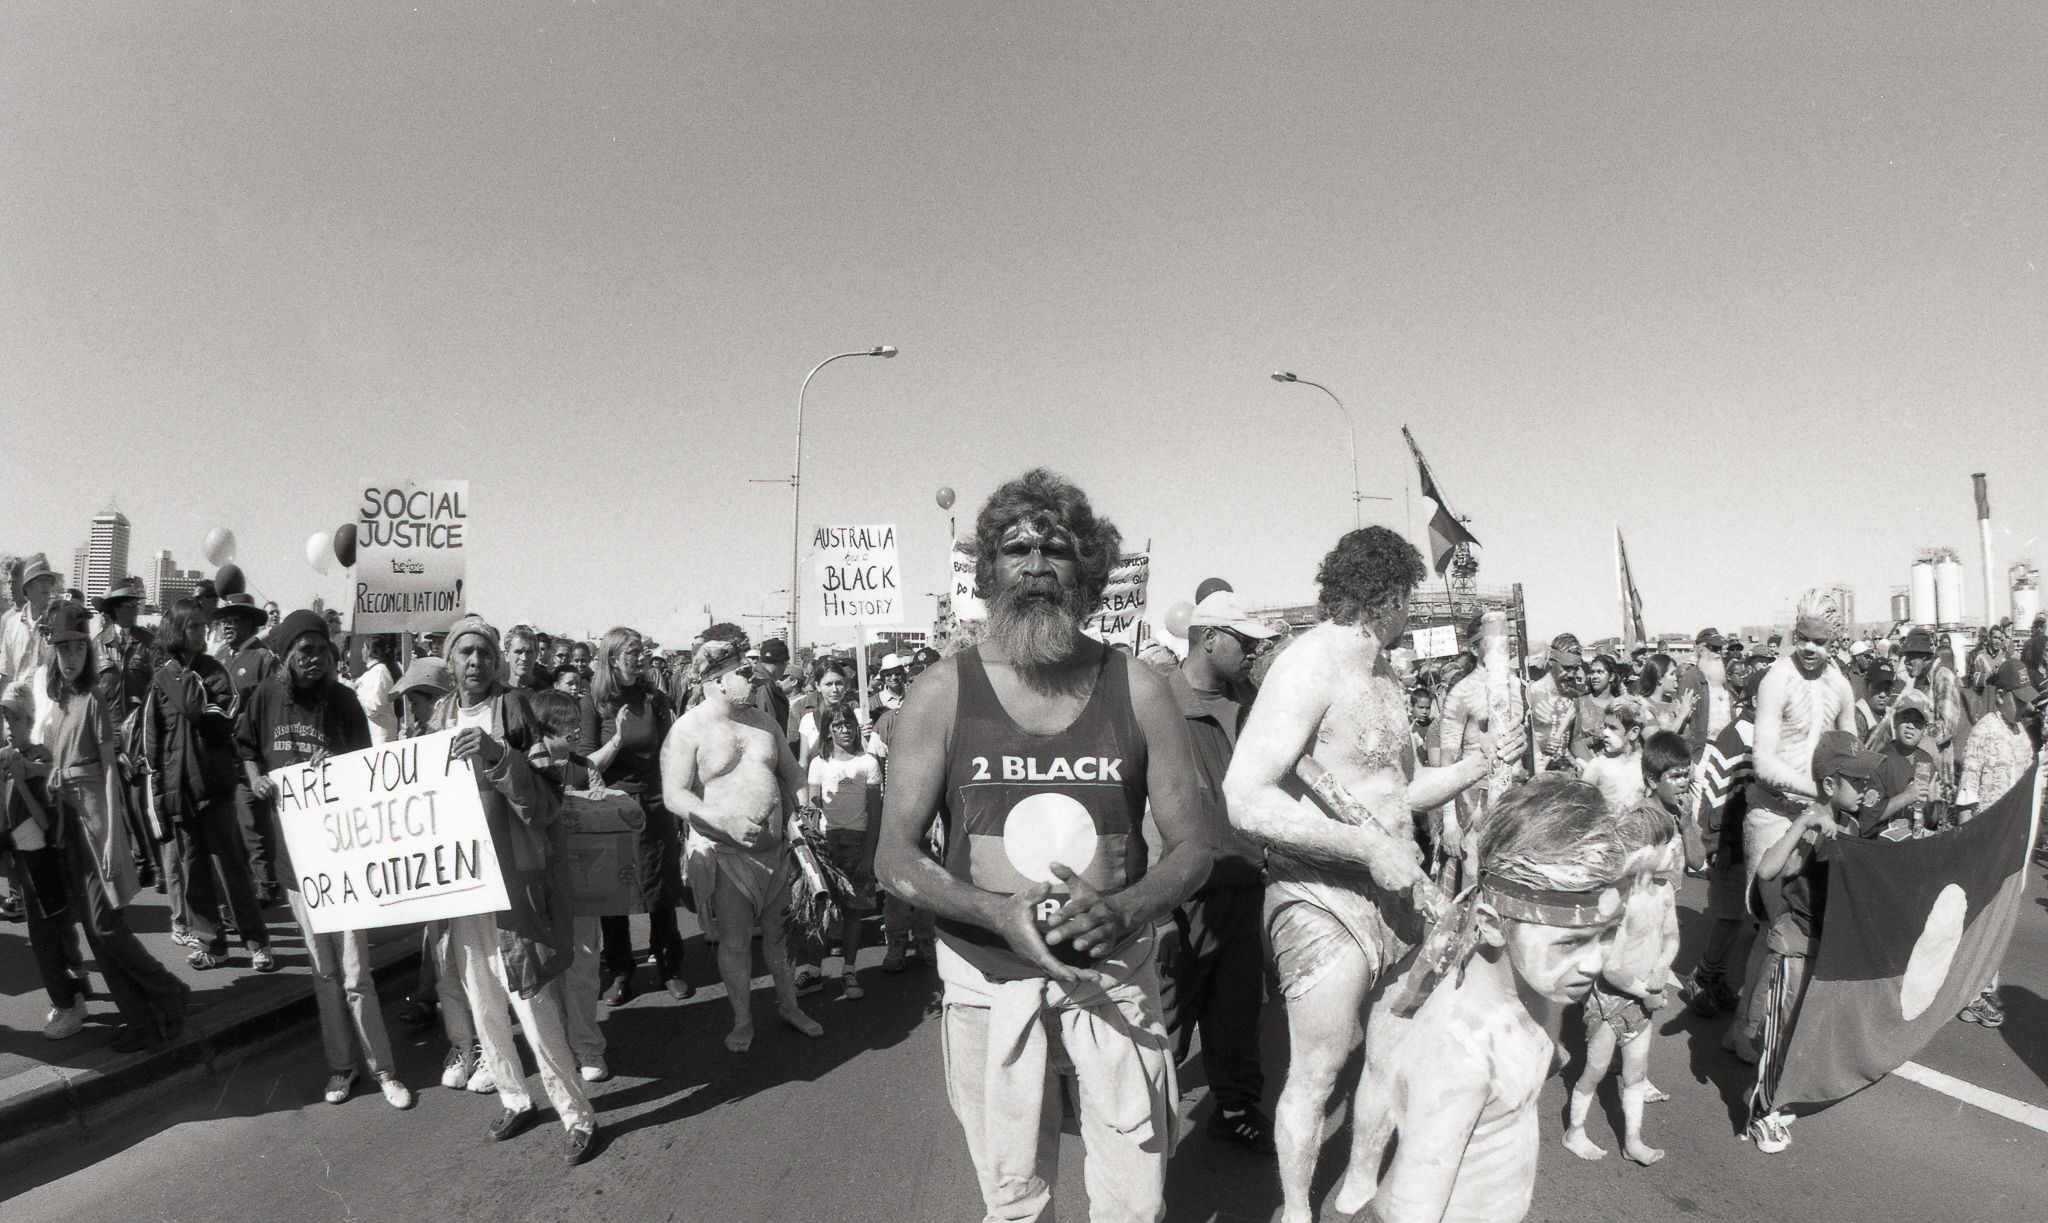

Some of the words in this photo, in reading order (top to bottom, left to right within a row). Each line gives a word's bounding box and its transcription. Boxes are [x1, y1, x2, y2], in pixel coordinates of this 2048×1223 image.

[360, 487, 467, 520] SOCIAL
[359, 520, 464, 549] JUSTICE
[813, 526, 895, 551] AUSTRALIA
[391, 558, 424, 572] before
[822, 565, 896, 591] BLACK
[356, 578, 464, 614] RECONCILIATION!
[823, 592, 893, 616] HISTORY
[1101, 589, 1145, 611] RBAL
[1100, 615, 1134, 634] LAW
[279, 762, 340, 813] ARE
[363, 742, 418, 793] YOU
[971, 756, 992, 781] 2
[1002, 755, 1123, 781] BLACK
[323, 789, 438, 853] SUBJECT
[302, 872, 335, 909] OR
[343, 870, 359, 903] A
